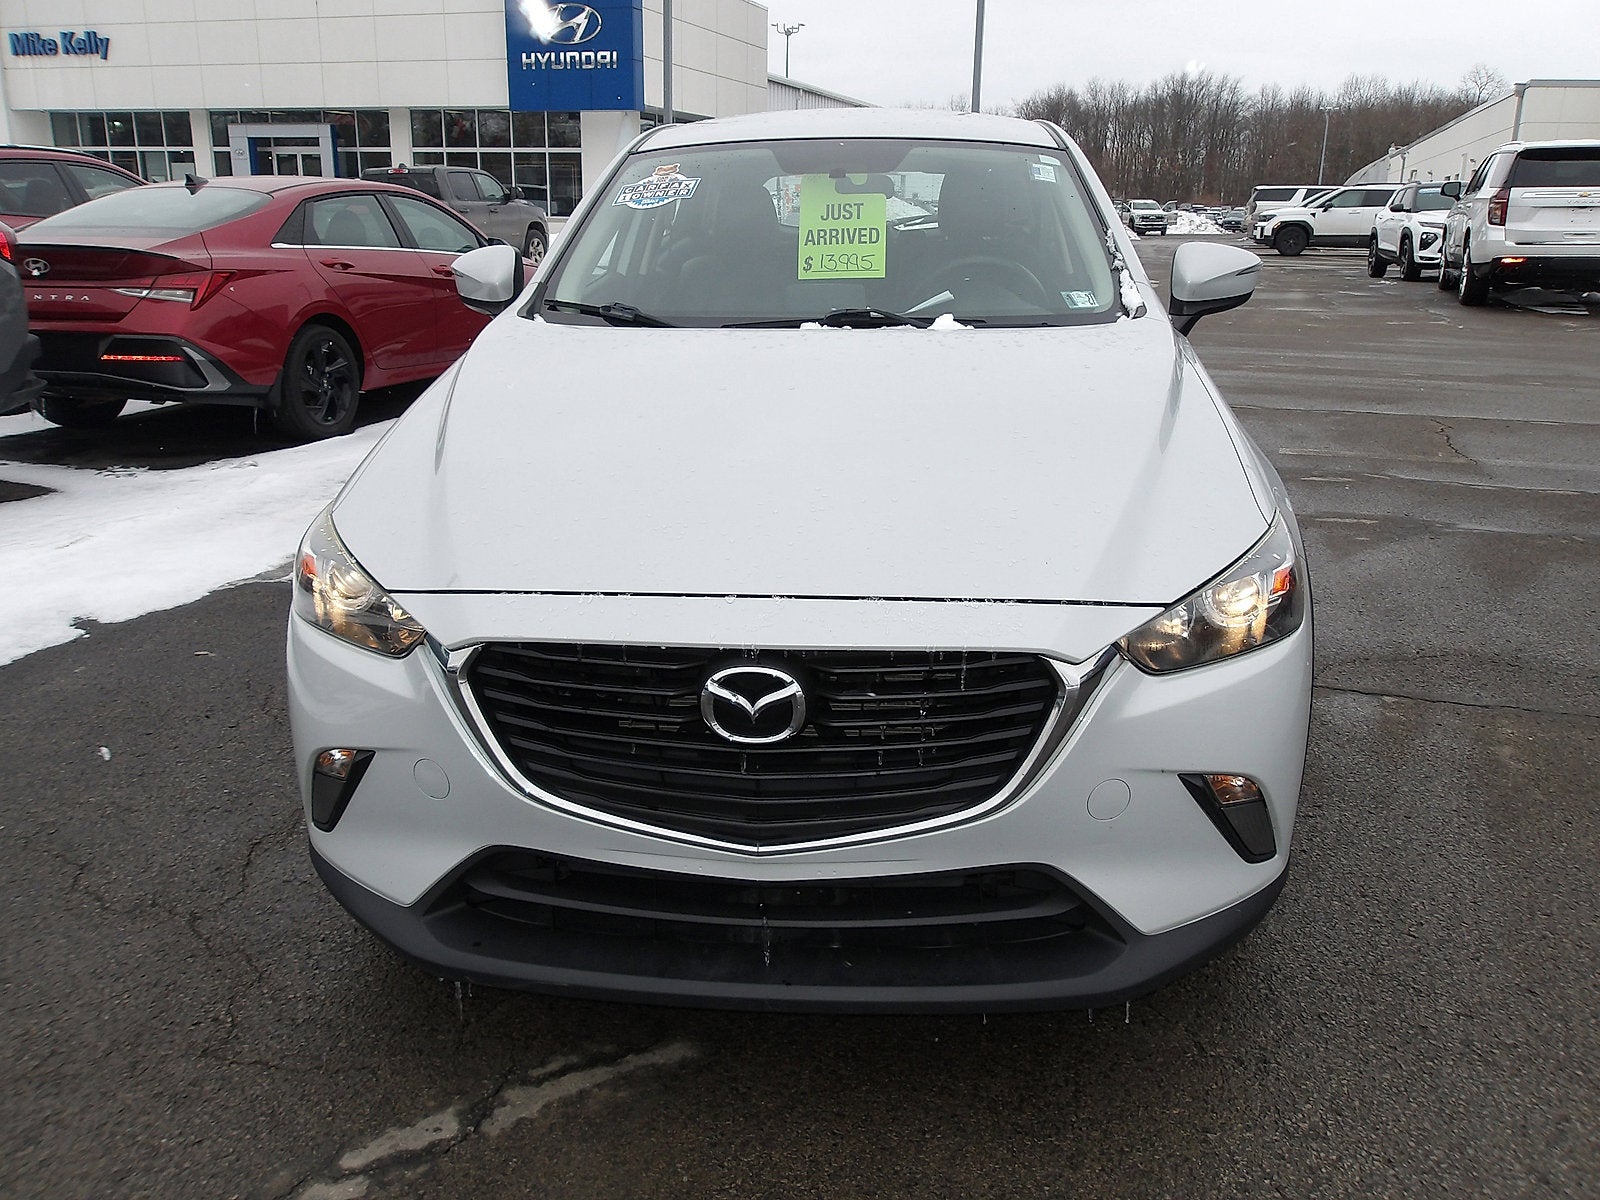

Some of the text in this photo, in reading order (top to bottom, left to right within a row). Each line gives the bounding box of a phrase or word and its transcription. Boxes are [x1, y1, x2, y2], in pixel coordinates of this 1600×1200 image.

[8, 30, 110, 60] Mike Kelly
[521, 50, 618, 70] HYUNDAI
[623, 181, 693, 195] CARFAX
[631, 189, 690, 200] OWNER
[820, 202, 864, 220] JUST
[804, 227, 880, 246] ARRIVED
[33, 294, 90, 302] NTRA
